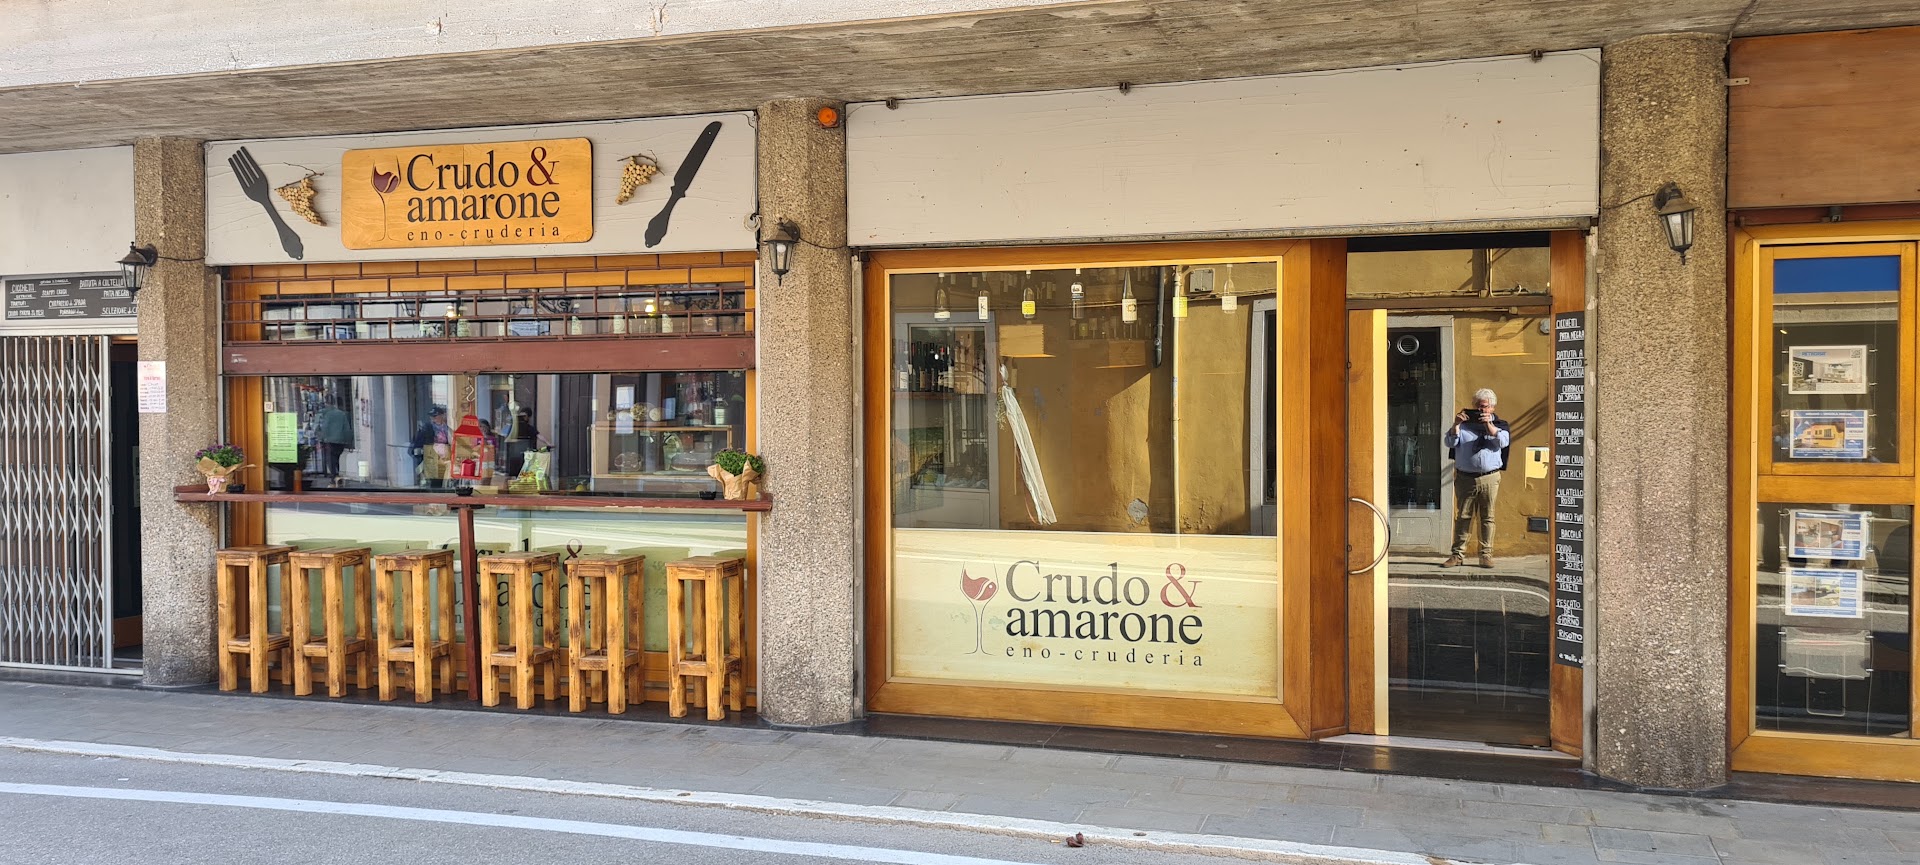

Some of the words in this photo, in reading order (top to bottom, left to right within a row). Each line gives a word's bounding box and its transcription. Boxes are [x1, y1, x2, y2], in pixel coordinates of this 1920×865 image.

[407, 150, 519, 191] Crudo
[526, 146, 560, 186] &
[407, 190, 560, 222] amarone
[407, 223, 560, 241] eno-cruderia
[1559, 469, 1584, 478] OSTRICH
[1006, 560, 1150, 606] Crudo
[1160, 562, 1203, 608] &
[1006, 607, 1203, 645] amarone
[1006, 646, 1203, 666] eno-cruderia
